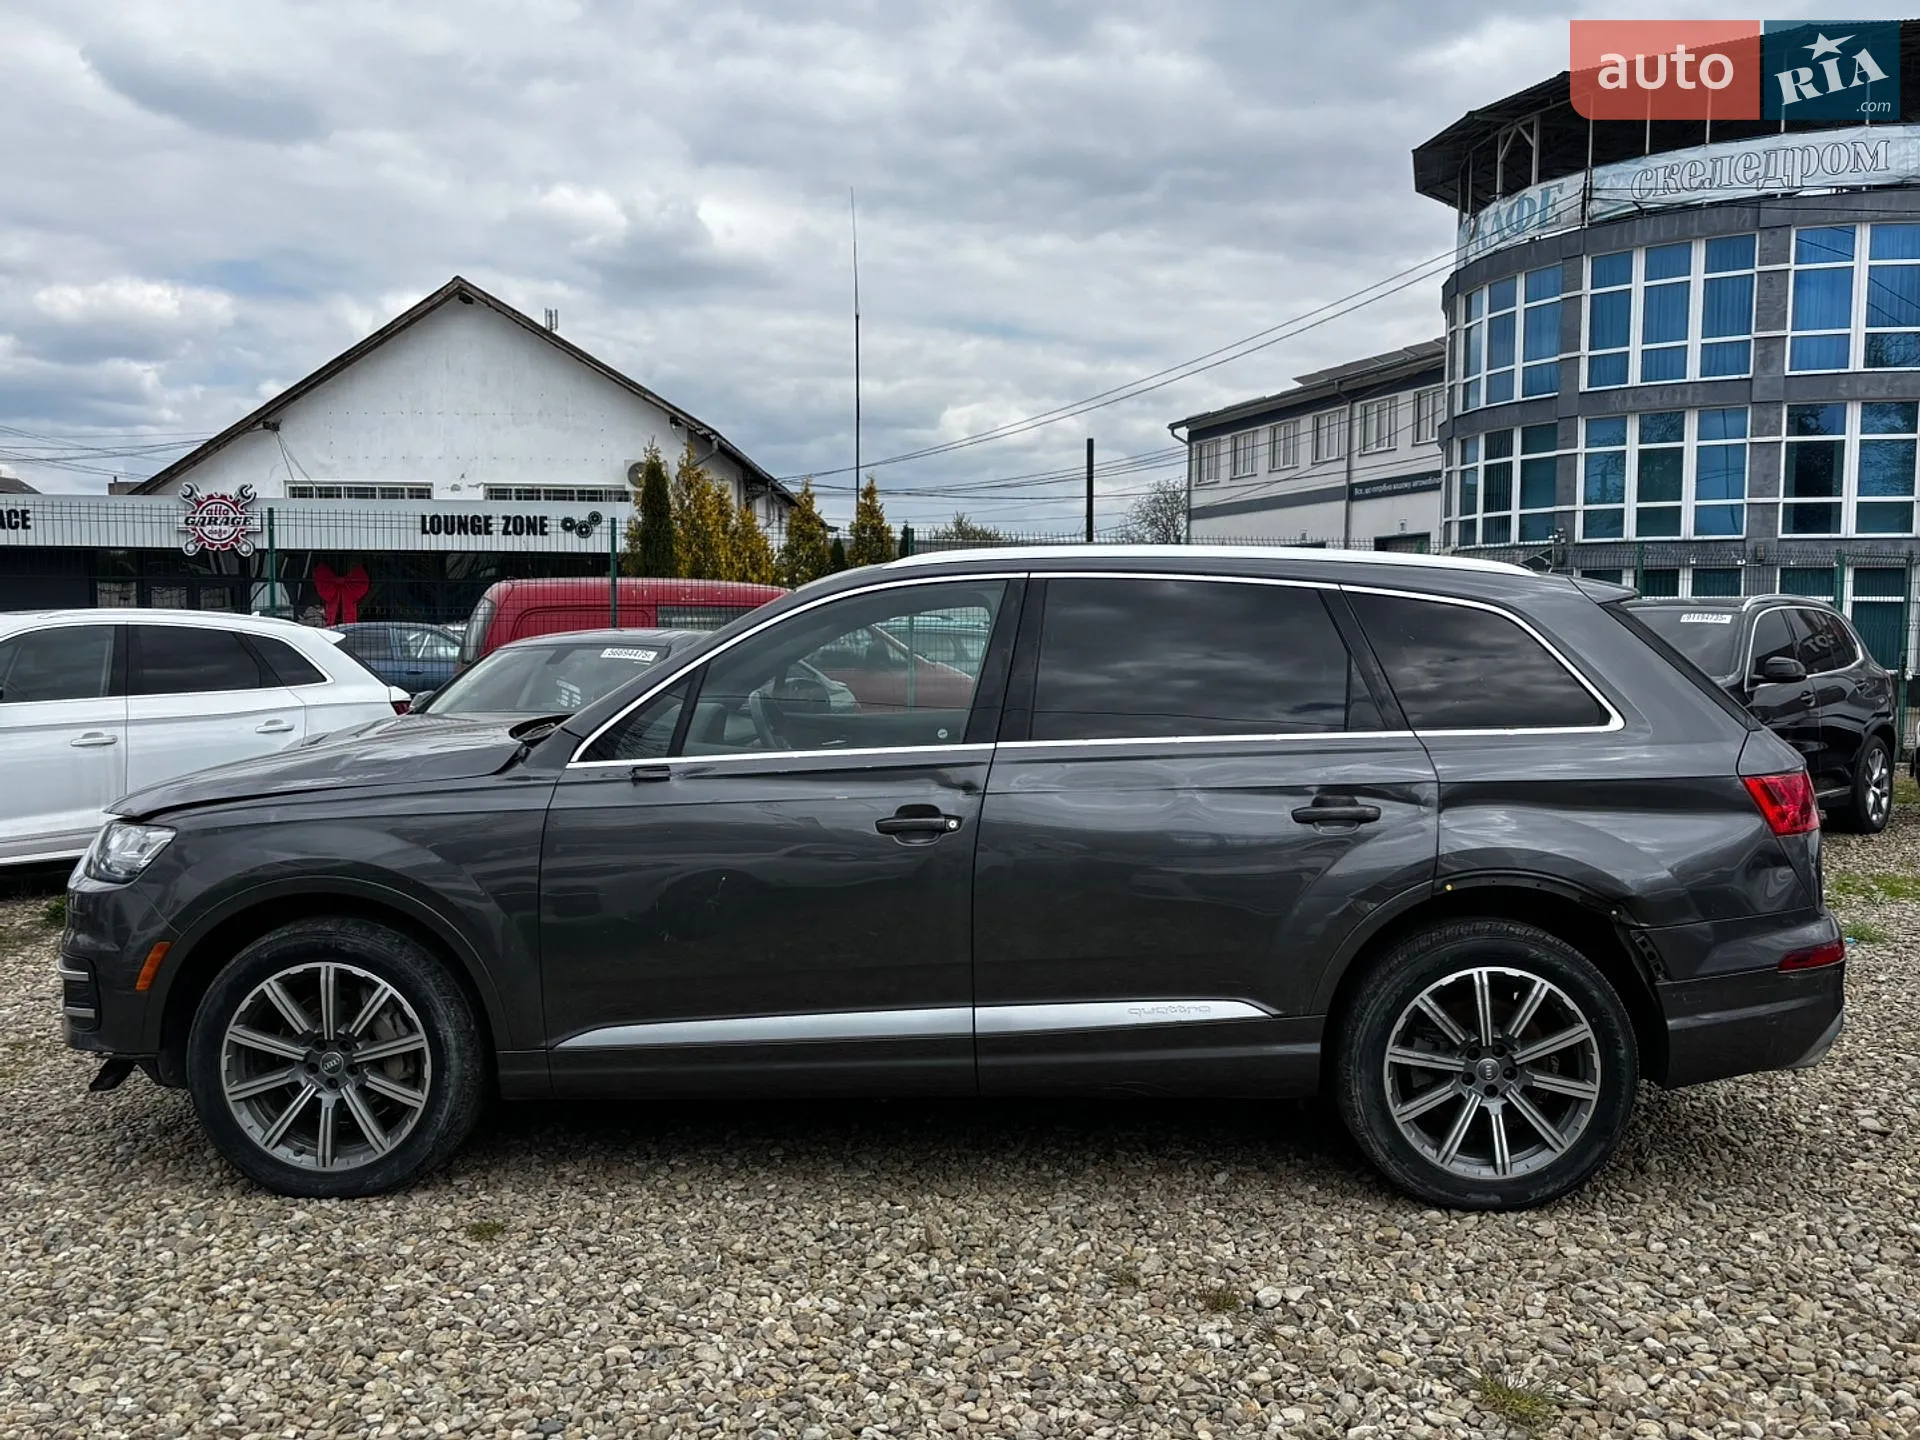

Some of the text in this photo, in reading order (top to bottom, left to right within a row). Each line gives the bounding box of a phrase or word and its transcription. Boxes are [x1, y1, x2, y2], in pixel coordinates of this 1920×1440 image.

[1630, 140, 1890, 201] скеледром
[184, 516, 254, 527] GARAGE
[421, 514, 548, 536] LOUNGE ZONE
[1128, 1005, 1211, 1016] quattro
